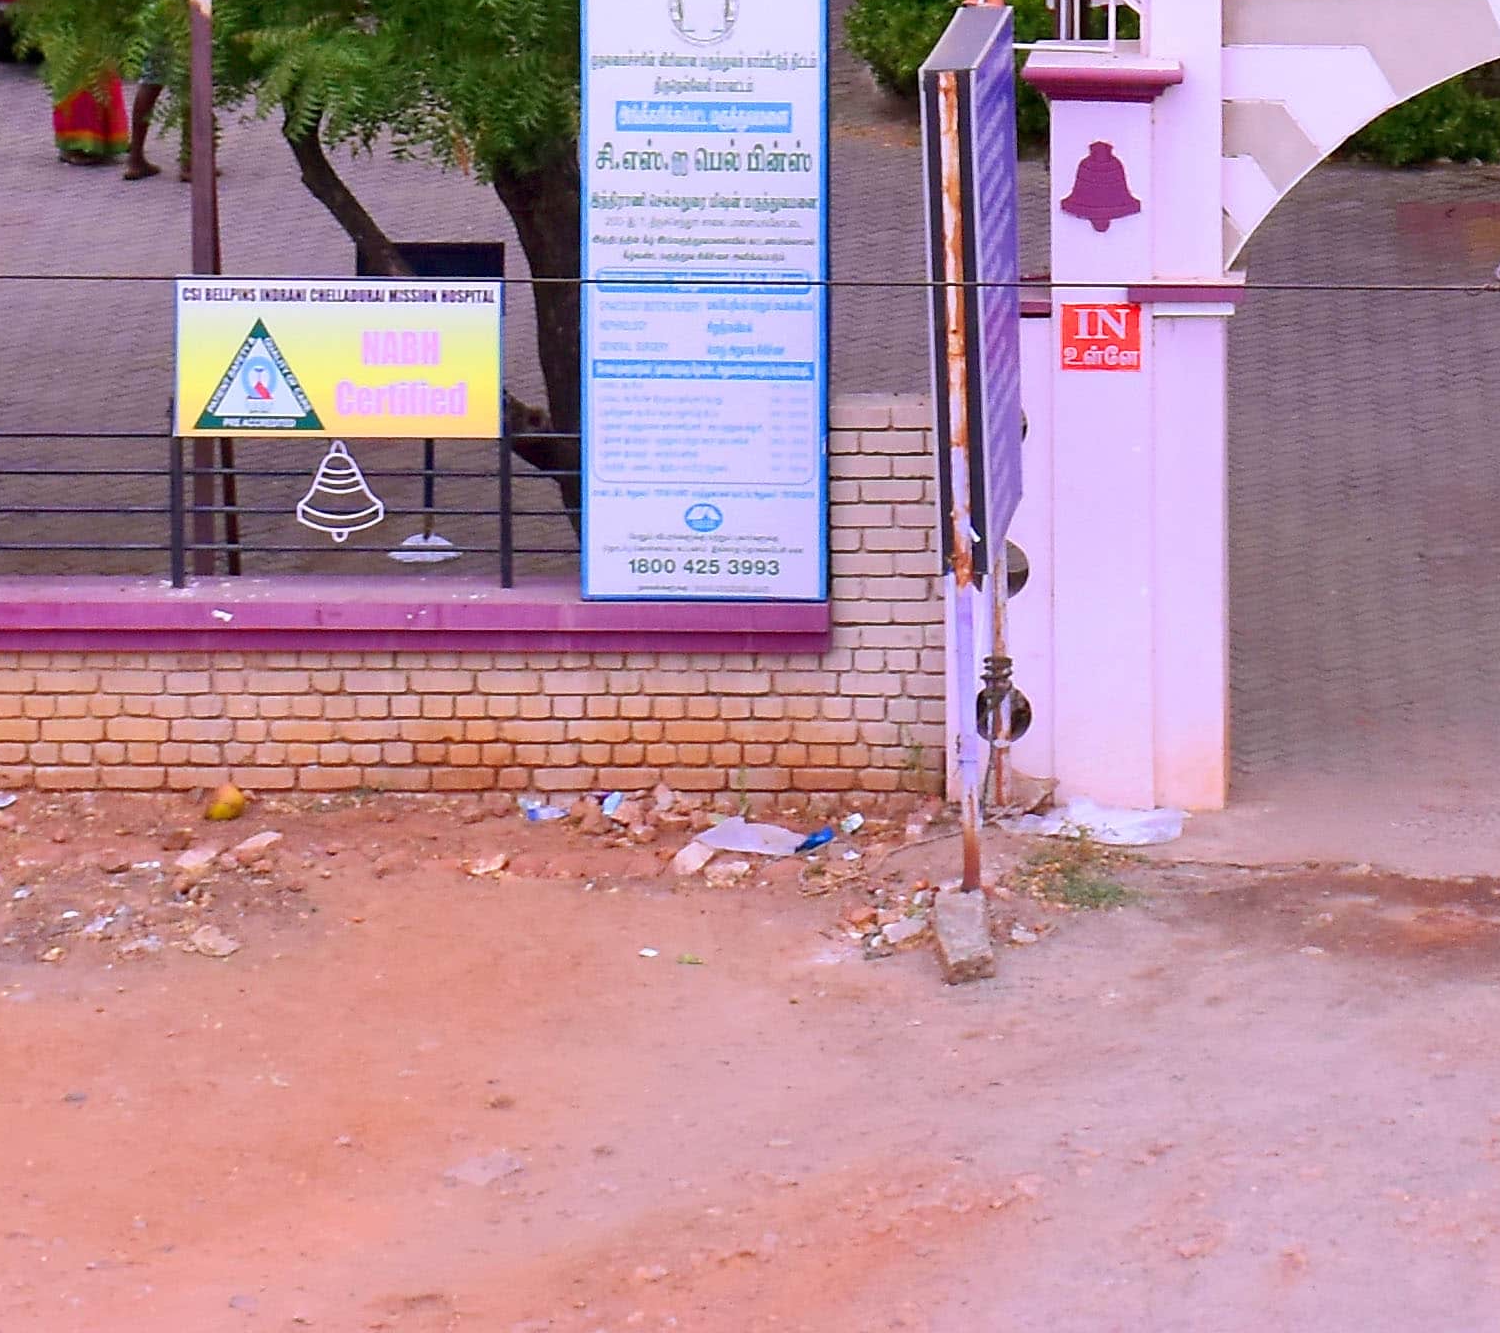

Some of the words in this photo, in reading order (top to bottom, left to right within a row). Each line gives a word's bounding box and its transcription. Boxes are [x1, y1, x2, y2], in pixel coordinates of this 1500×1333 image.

[695, 138, 741, 172] பெல்
[747, 140, 812, 172] பின்ஸ்
[1072, 307, 1130, 340] IN
[362, 330, 443, 365] NABH
[1063, 344, 1140, 366] உள்ளே
[336, 380, 469, 416] Certified
[628, 559, 676, 574] 1800
[683, 559, 721, 575] 425
[727, 560, 780, 576] 3993
